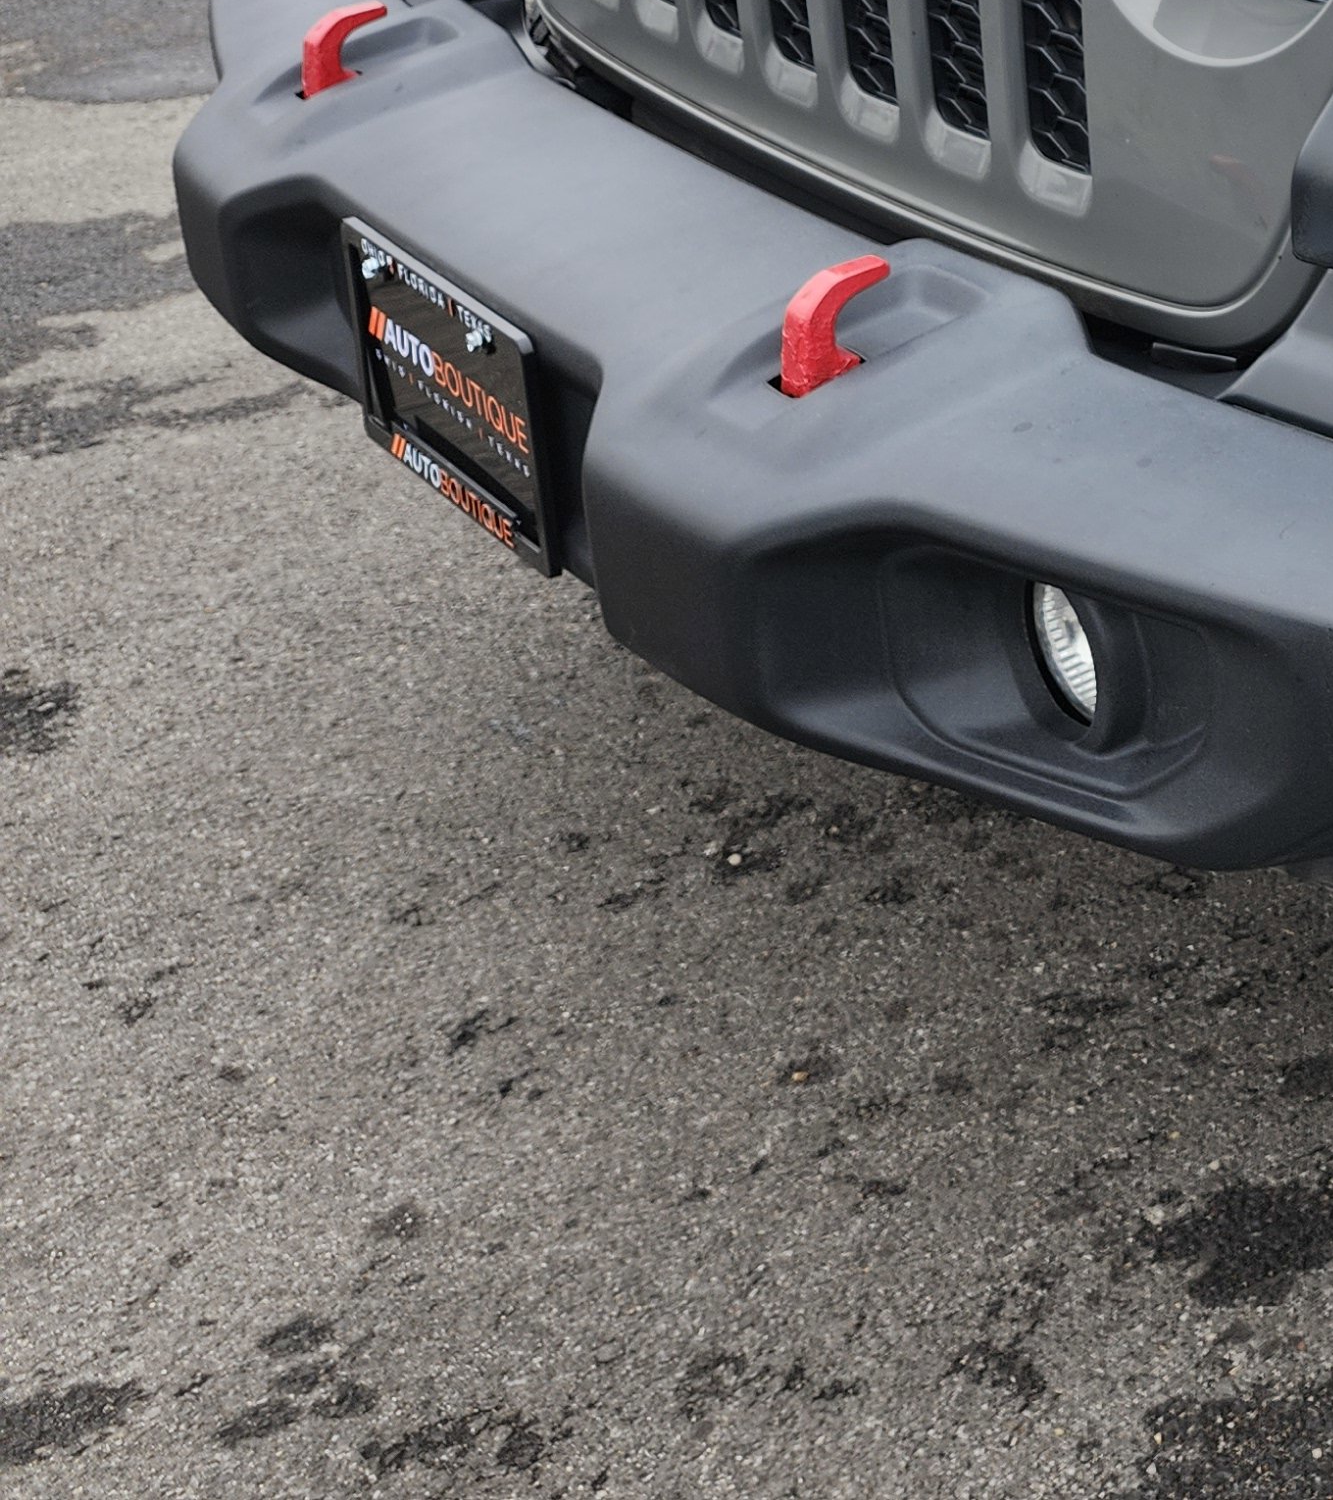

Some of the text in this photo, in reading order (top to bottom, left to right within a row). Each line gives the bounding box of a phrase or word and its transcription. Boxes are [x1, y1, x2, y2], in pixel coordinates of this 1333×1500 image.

[397, 263, 445, 310] FLORIDA
[384, 318, 529, 455] AUTOBOUTIQUE
[403, 443, 516, 549] AUTOBOUTIQUE
